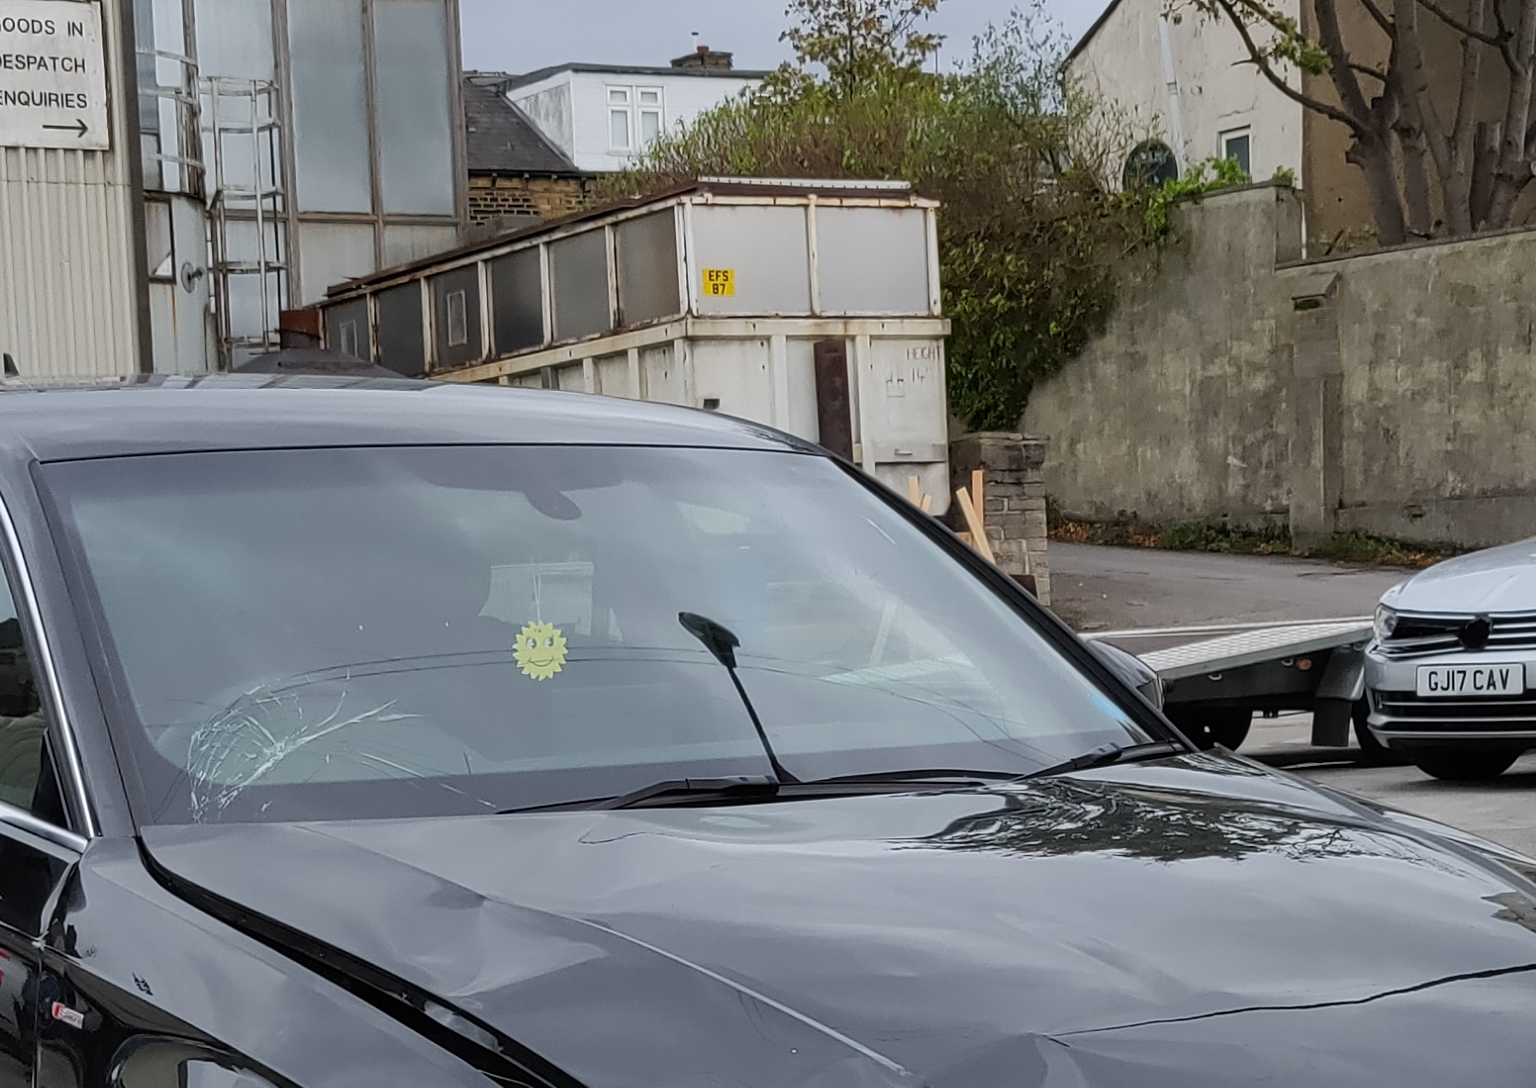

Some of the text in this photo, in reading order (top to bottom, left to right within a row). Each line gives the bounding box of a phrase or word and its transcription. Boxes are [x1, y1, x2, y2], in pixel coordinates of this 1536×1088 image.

[67, 21, 83, 37] IN
[708, 269, 729, 282] EFS
[1428, 668, 1510, 692] GJ17 CAV
